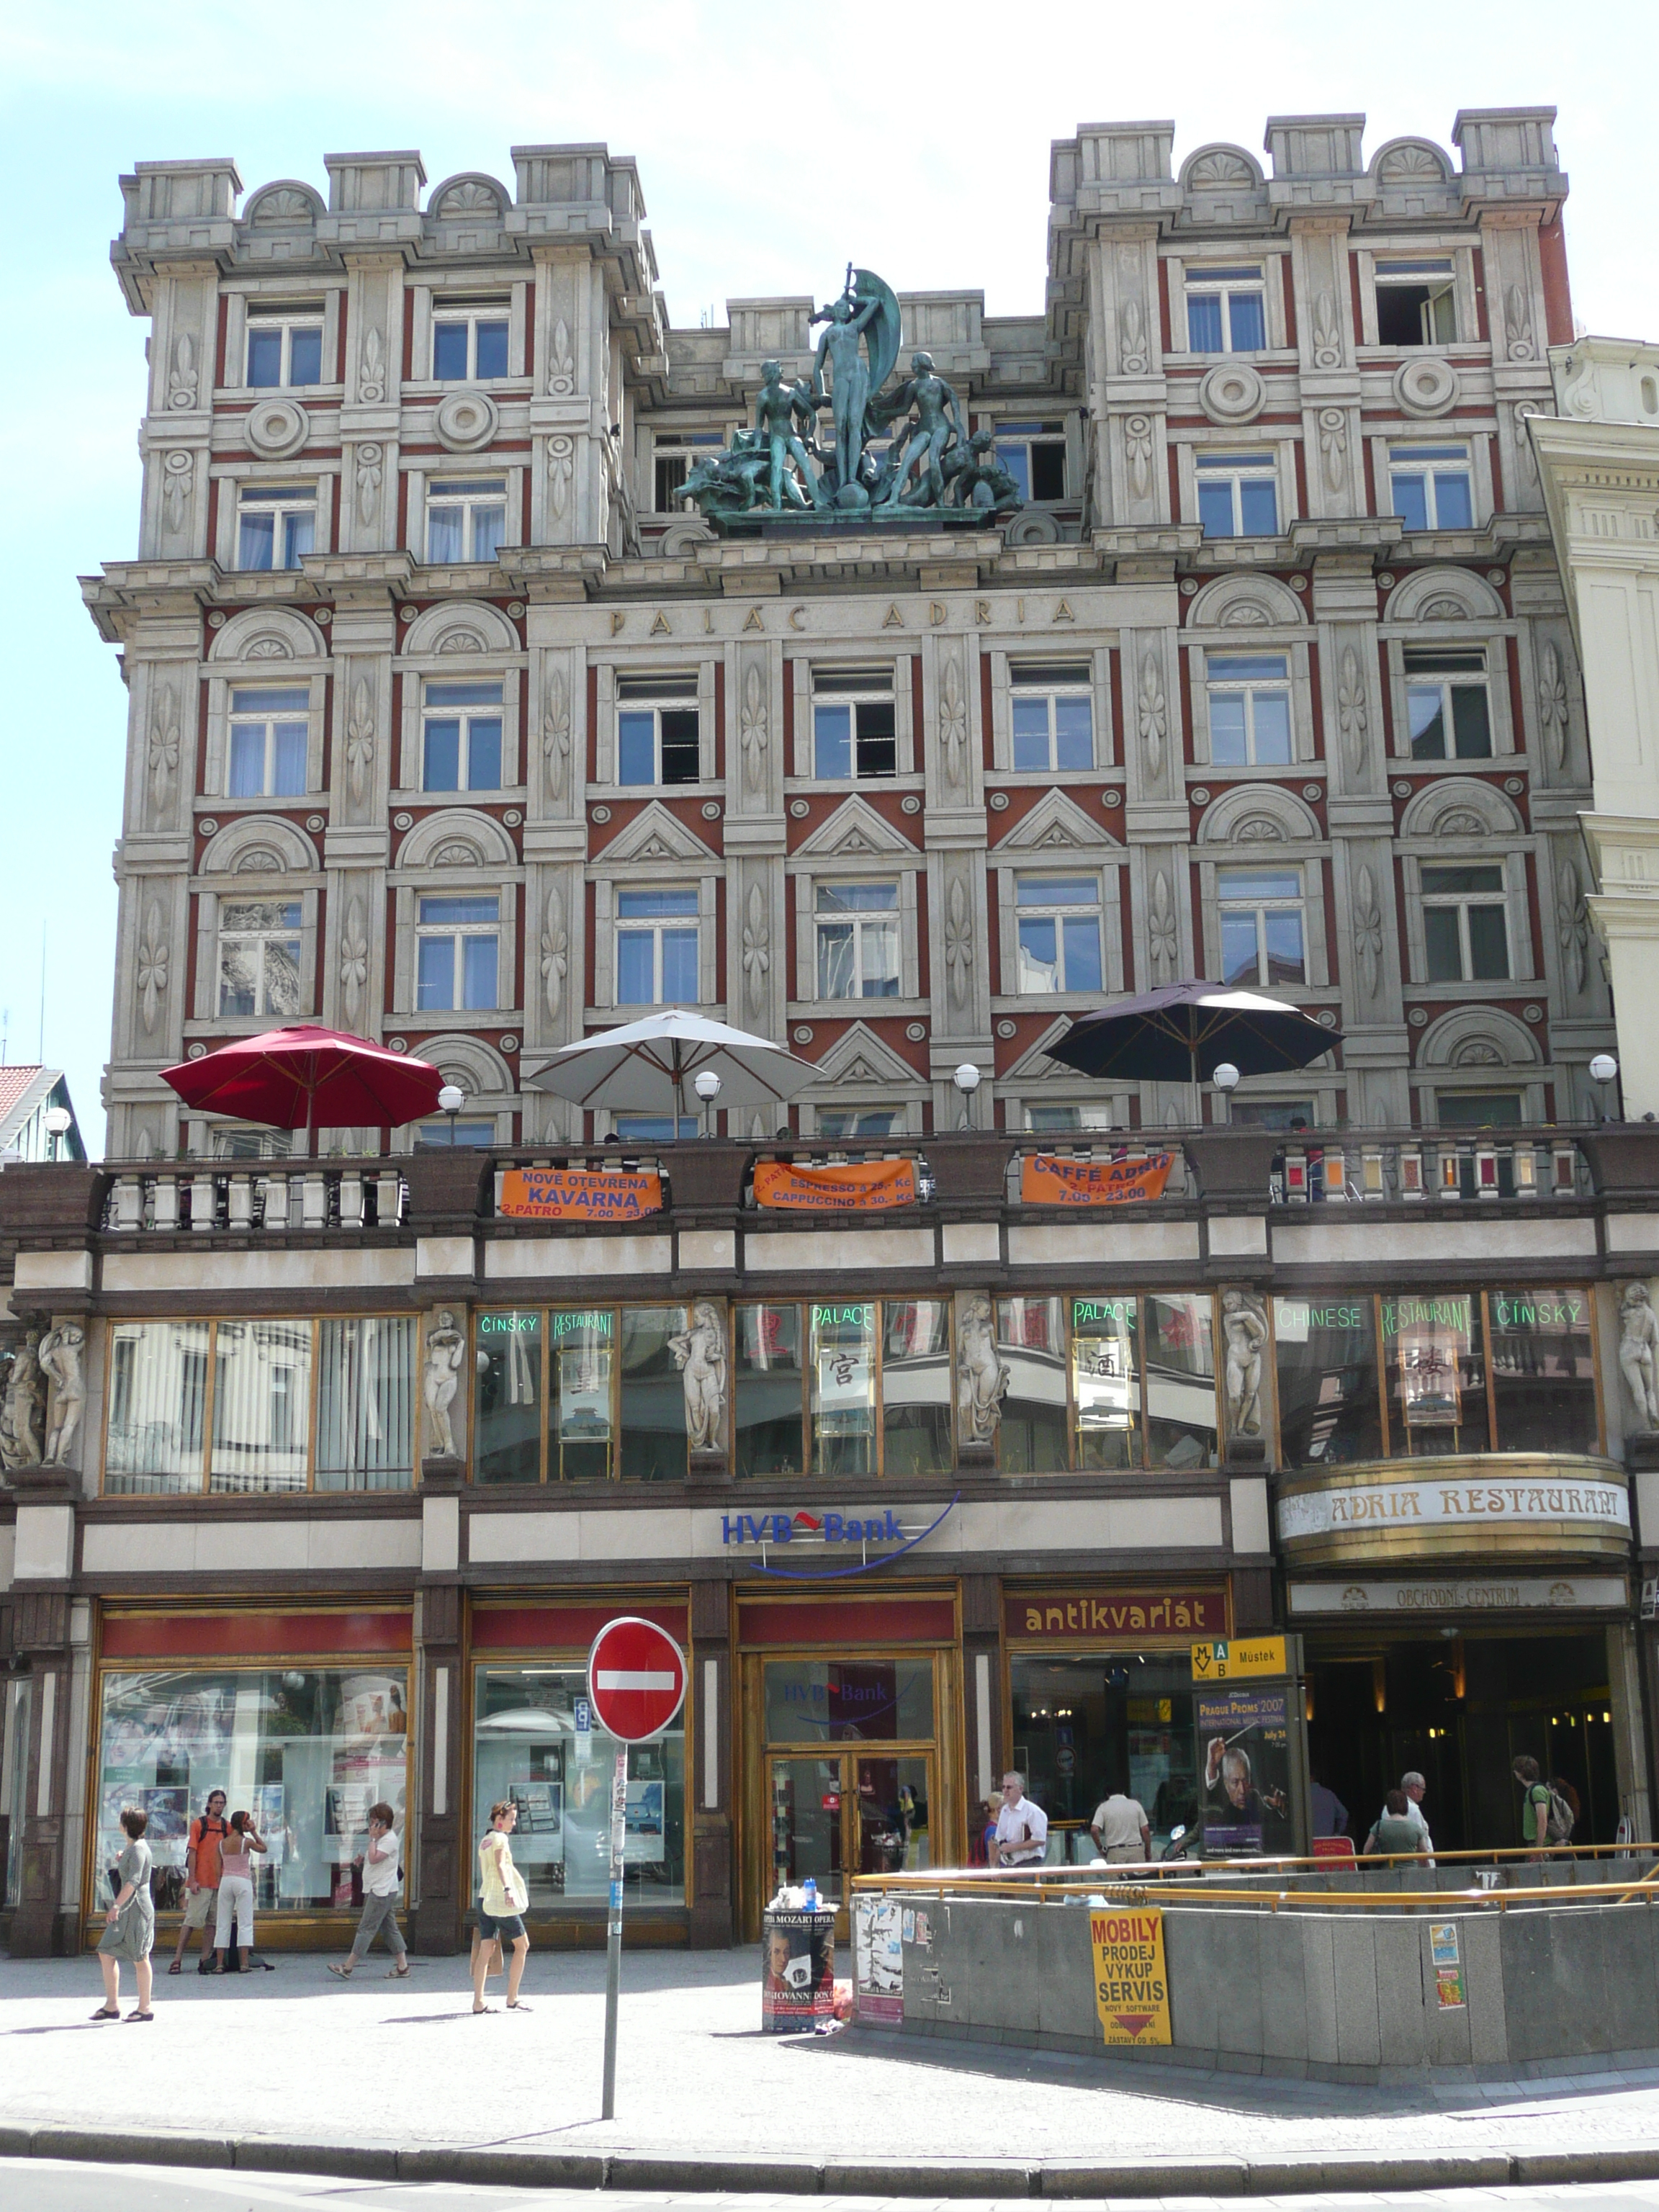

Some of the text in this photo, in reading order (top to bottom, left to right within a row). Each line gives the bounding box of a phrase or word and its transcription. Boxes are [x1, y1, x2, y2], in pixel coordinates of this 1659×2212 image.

[611, 598, 1075, 637] PALÁC ADRIA
[523, 1172, 563, 1185] NOVĚ
[1034, 1157, 1102, 1182] CAFFÉ
[791, 1178, 855, 1192] ESPRESSO
[895, 1178, 912, 1187] Kč
[1059, 1190, 1091, 1202] 7.00
[1105, 1187, 1146, 1202] 23.00
[529, 1187, 639, 1208] KAVÁRNA
[773, 1191, 855, 1207] CAPPUCCINO
[896, 1193, 913, 1202] Kč
[587, 1209, 613, 1218] 7.00
[812, 1306, 873, 1332] PALACE
[1074, 1303, 1136, 1329] PALACE
[1279, 1299, 1581, 1342] CHINESE RESTAURANT ČÍNSKÝ
[482, 1314, 612, 1340] ČÍNSKÝ RESTAURANT
[1331, 1488, 1618, 1522] ADRIA RESTAURANT
[721, 1510, 906, 1544] HVB Bank
[1465, 1586, 1521, 1606] CENTRUM
[1025, 1598, 1205, 1631] antikvariát
[1217, 1644, 1226, 1658] A
[1218, 1663, 1226, 1677] B
[784, 1682, 887, 1701] HVB Bank
[1092, 1917, 1159, 1943] MOBILY
[1102, 1945, 1155, 1961] PRODEJ
[1105, 1960, 1152, 1979] VÝKUP
[814, 1991, 829, 2000] DON
[1099, 1981, 1164, 2002] SERVIS
